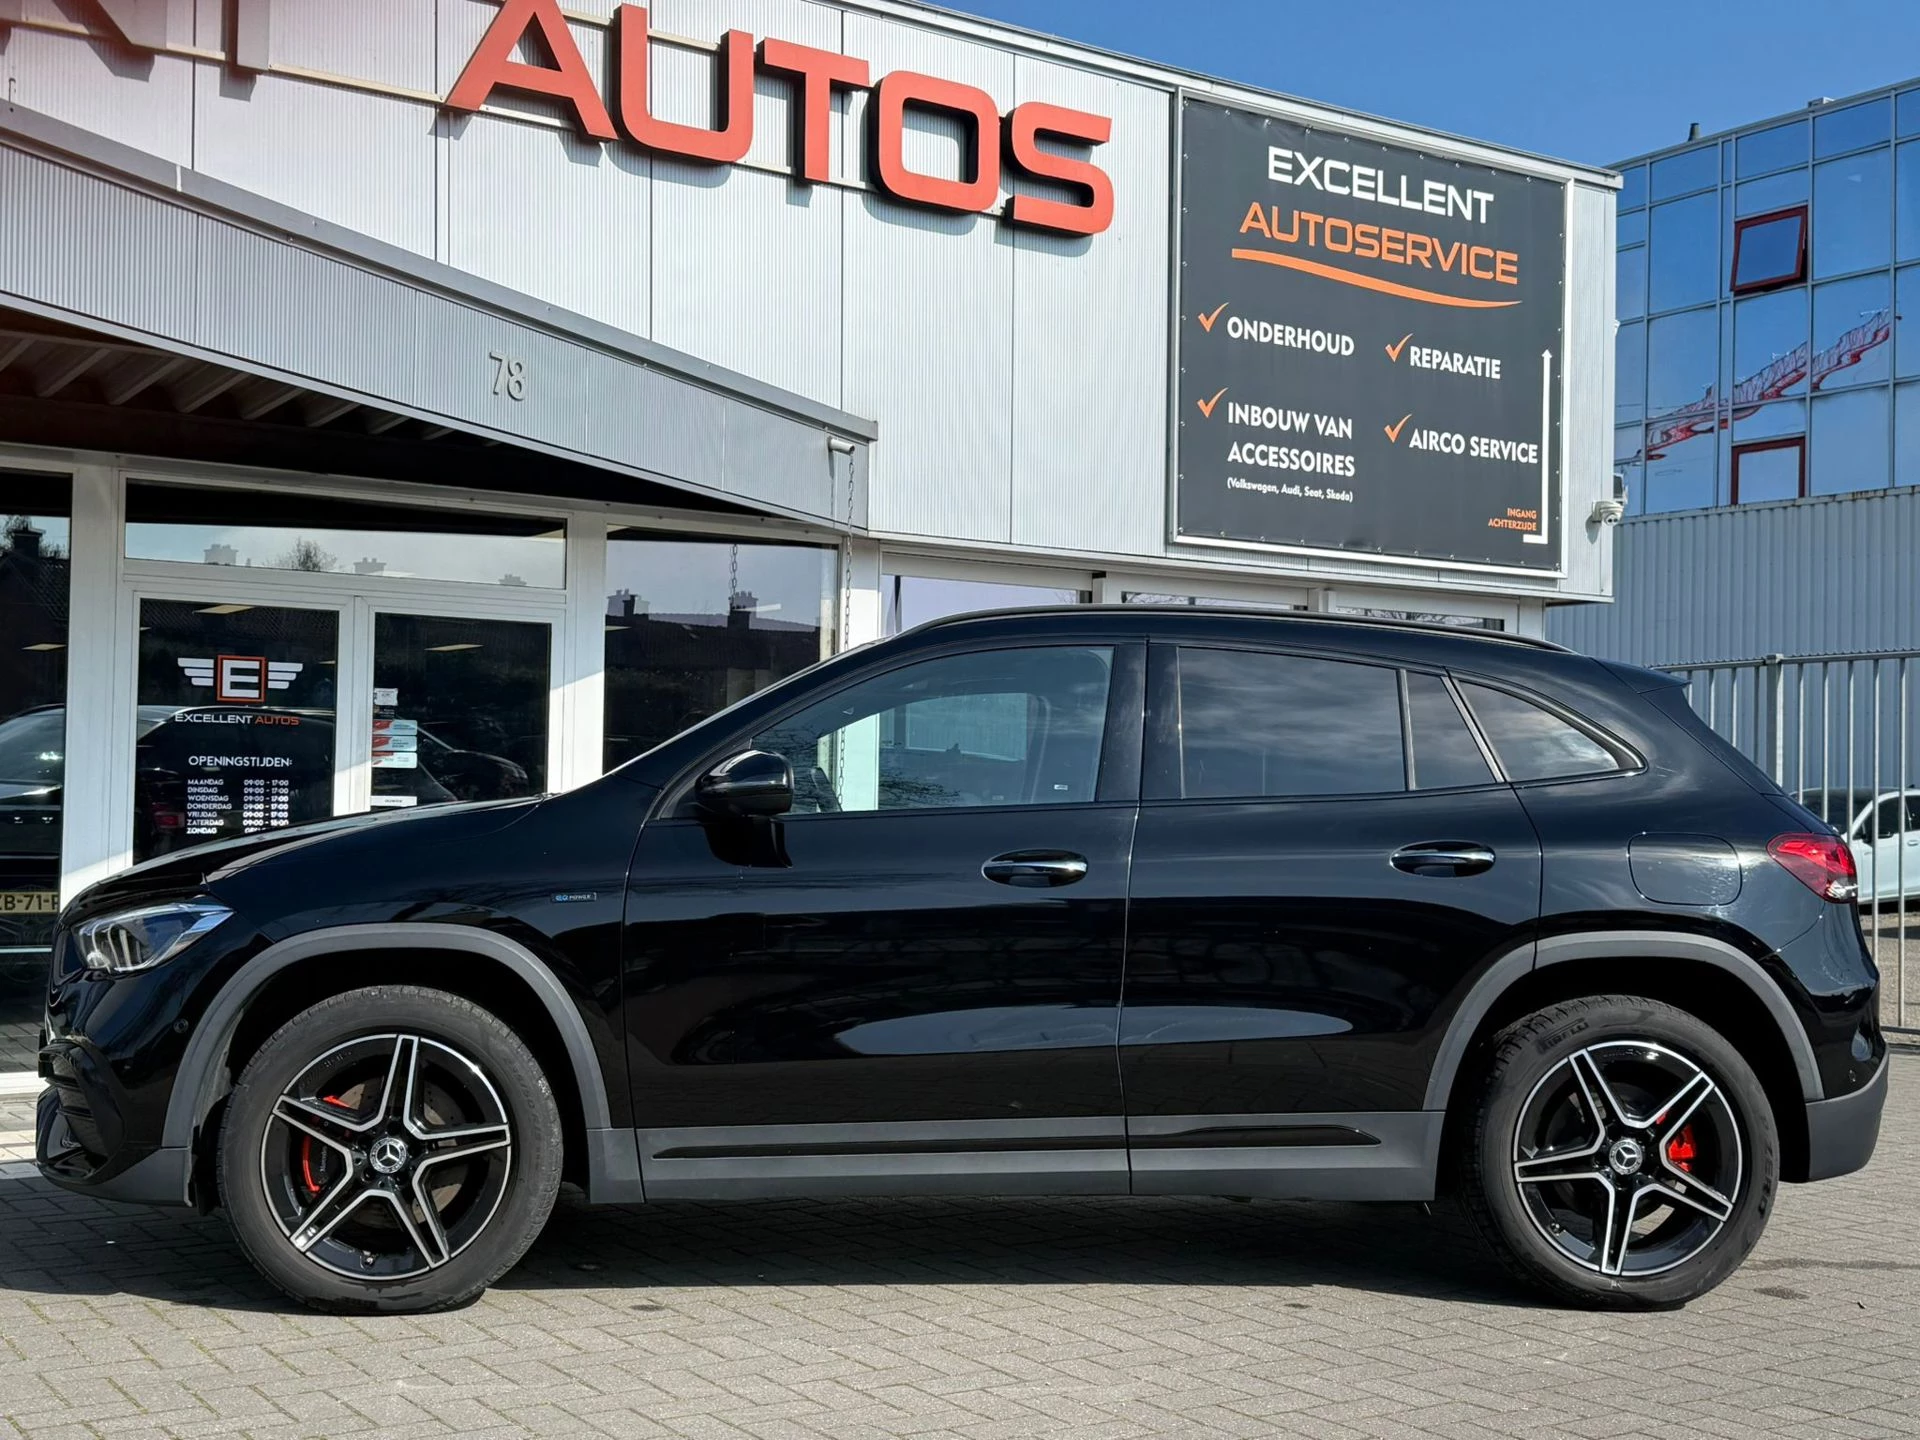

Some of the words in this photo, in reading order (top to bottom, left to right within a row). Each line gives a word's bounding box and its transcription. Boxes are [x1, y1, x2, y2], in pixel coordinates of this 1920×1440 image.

[445, 0, 1114, 236] AUTOS
[1267, 145, 1495, 224] EXCELLENT
[1239, 201, 1518, 285] AUTOSERVICE
[1227, 316, 1355, 357] ONDERHOUD
[489, 351, 527, 401] 78
[1409, 346, 1501, 380] REPARATIE
[1227, 402, 1309, 434] INBOUW
[1314, 414, 1353, 440] VAN
[1227, 441, 1355, 478] ACCESSOIRES
[1409, 429, 1465, 456] AIRCO
[1470, 436, 1538, 465] SERVICE
[1227, 476, 1279, 494] (Volkswagen,
[1281, 484, 1302, 497] Audi,
[1304, 486, 1324, 499] Seat,
[1326, 488, 1353, 502] Skoda)
[1488, 518, 1537, 531] ACHTERZIJDE
[1507, 508, 1537, 519] INGANG
[221, 659, 260, 698] E
[174, 714, 253, 724] EXCELLENT
[255, 716, 299, 725] AUTOS
[188, 755, 292, 767] OPENINGSTIJDEN:
[186, 827, 217, 835] ZONDAG
[0, 894, 58, 910] B-71-
